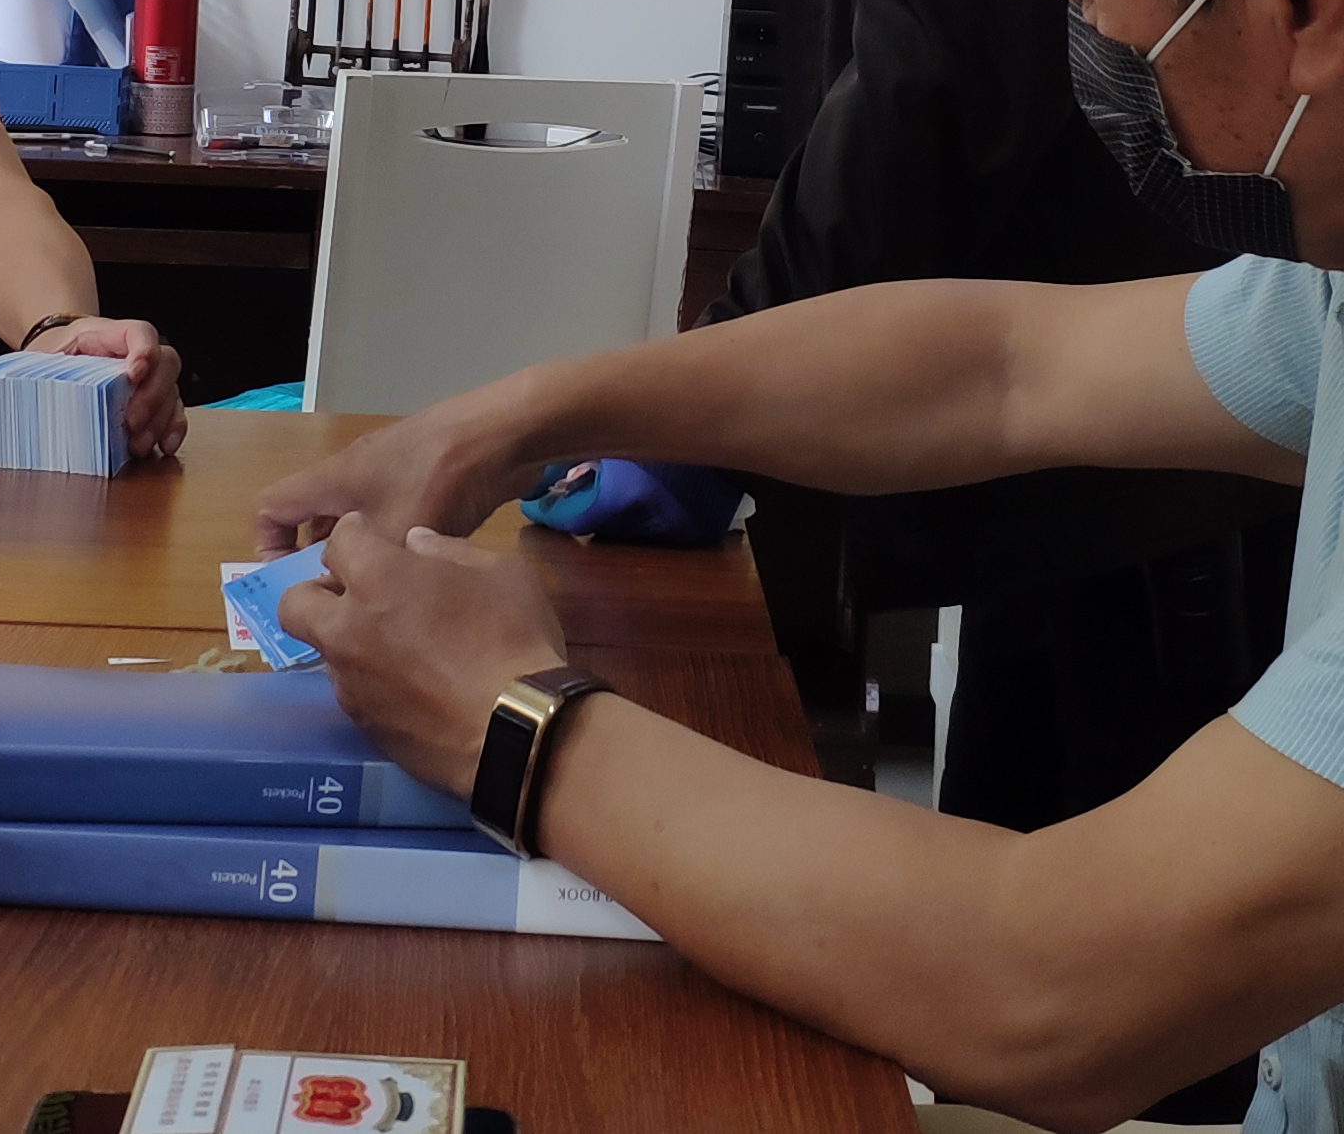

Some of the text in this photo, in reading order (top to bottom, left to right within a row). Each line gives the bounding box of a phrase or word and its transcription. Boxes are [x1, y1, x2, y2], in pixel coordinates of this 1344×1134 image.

[262, 787, 306, 800] Pockets
[315, 776, 344, 815] 40
[210, 871, 258, 886] Pockets
[268, 858, 299, 903] 40
